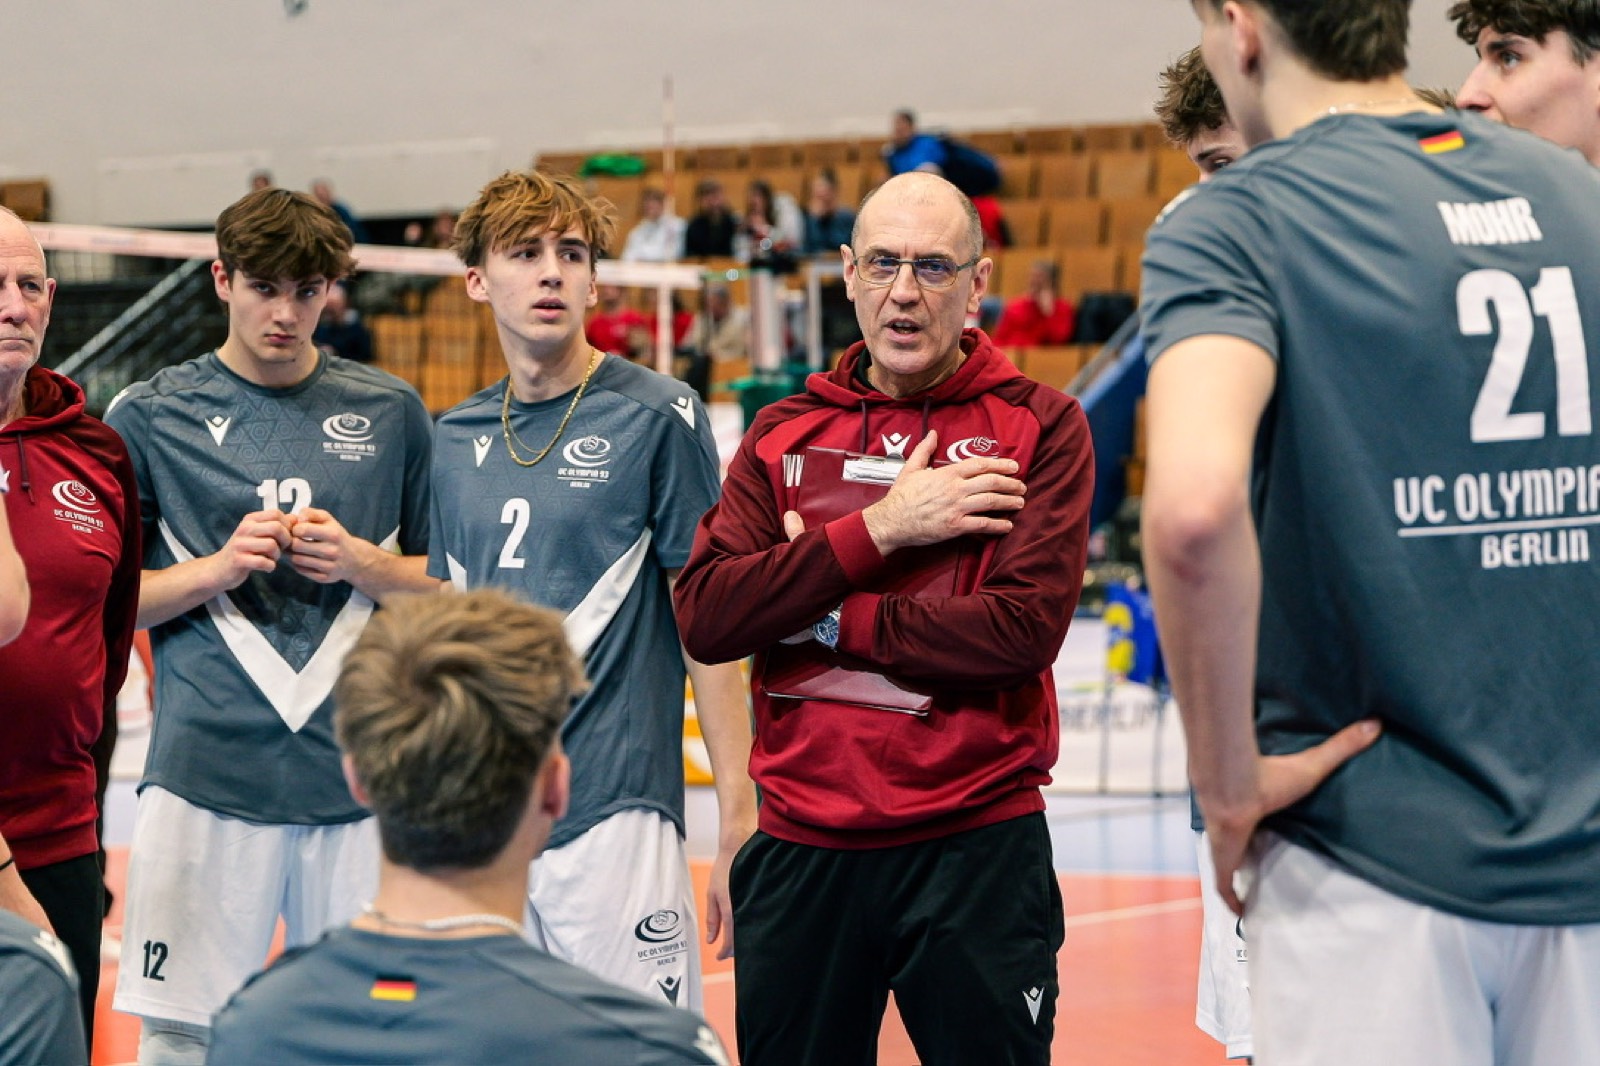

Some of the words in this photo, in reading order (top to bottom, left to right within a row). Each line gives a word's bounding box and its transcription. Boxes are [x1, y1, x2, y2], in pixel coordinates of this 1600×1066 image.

[1437, 197, 1543, 245] MOHR
[1456, 265, 1592, 442] 21
[498, 497, 531, 569] 2
[1481, 528, 1590, 569] BERLIN
[143, 940, 169, 981] 12
